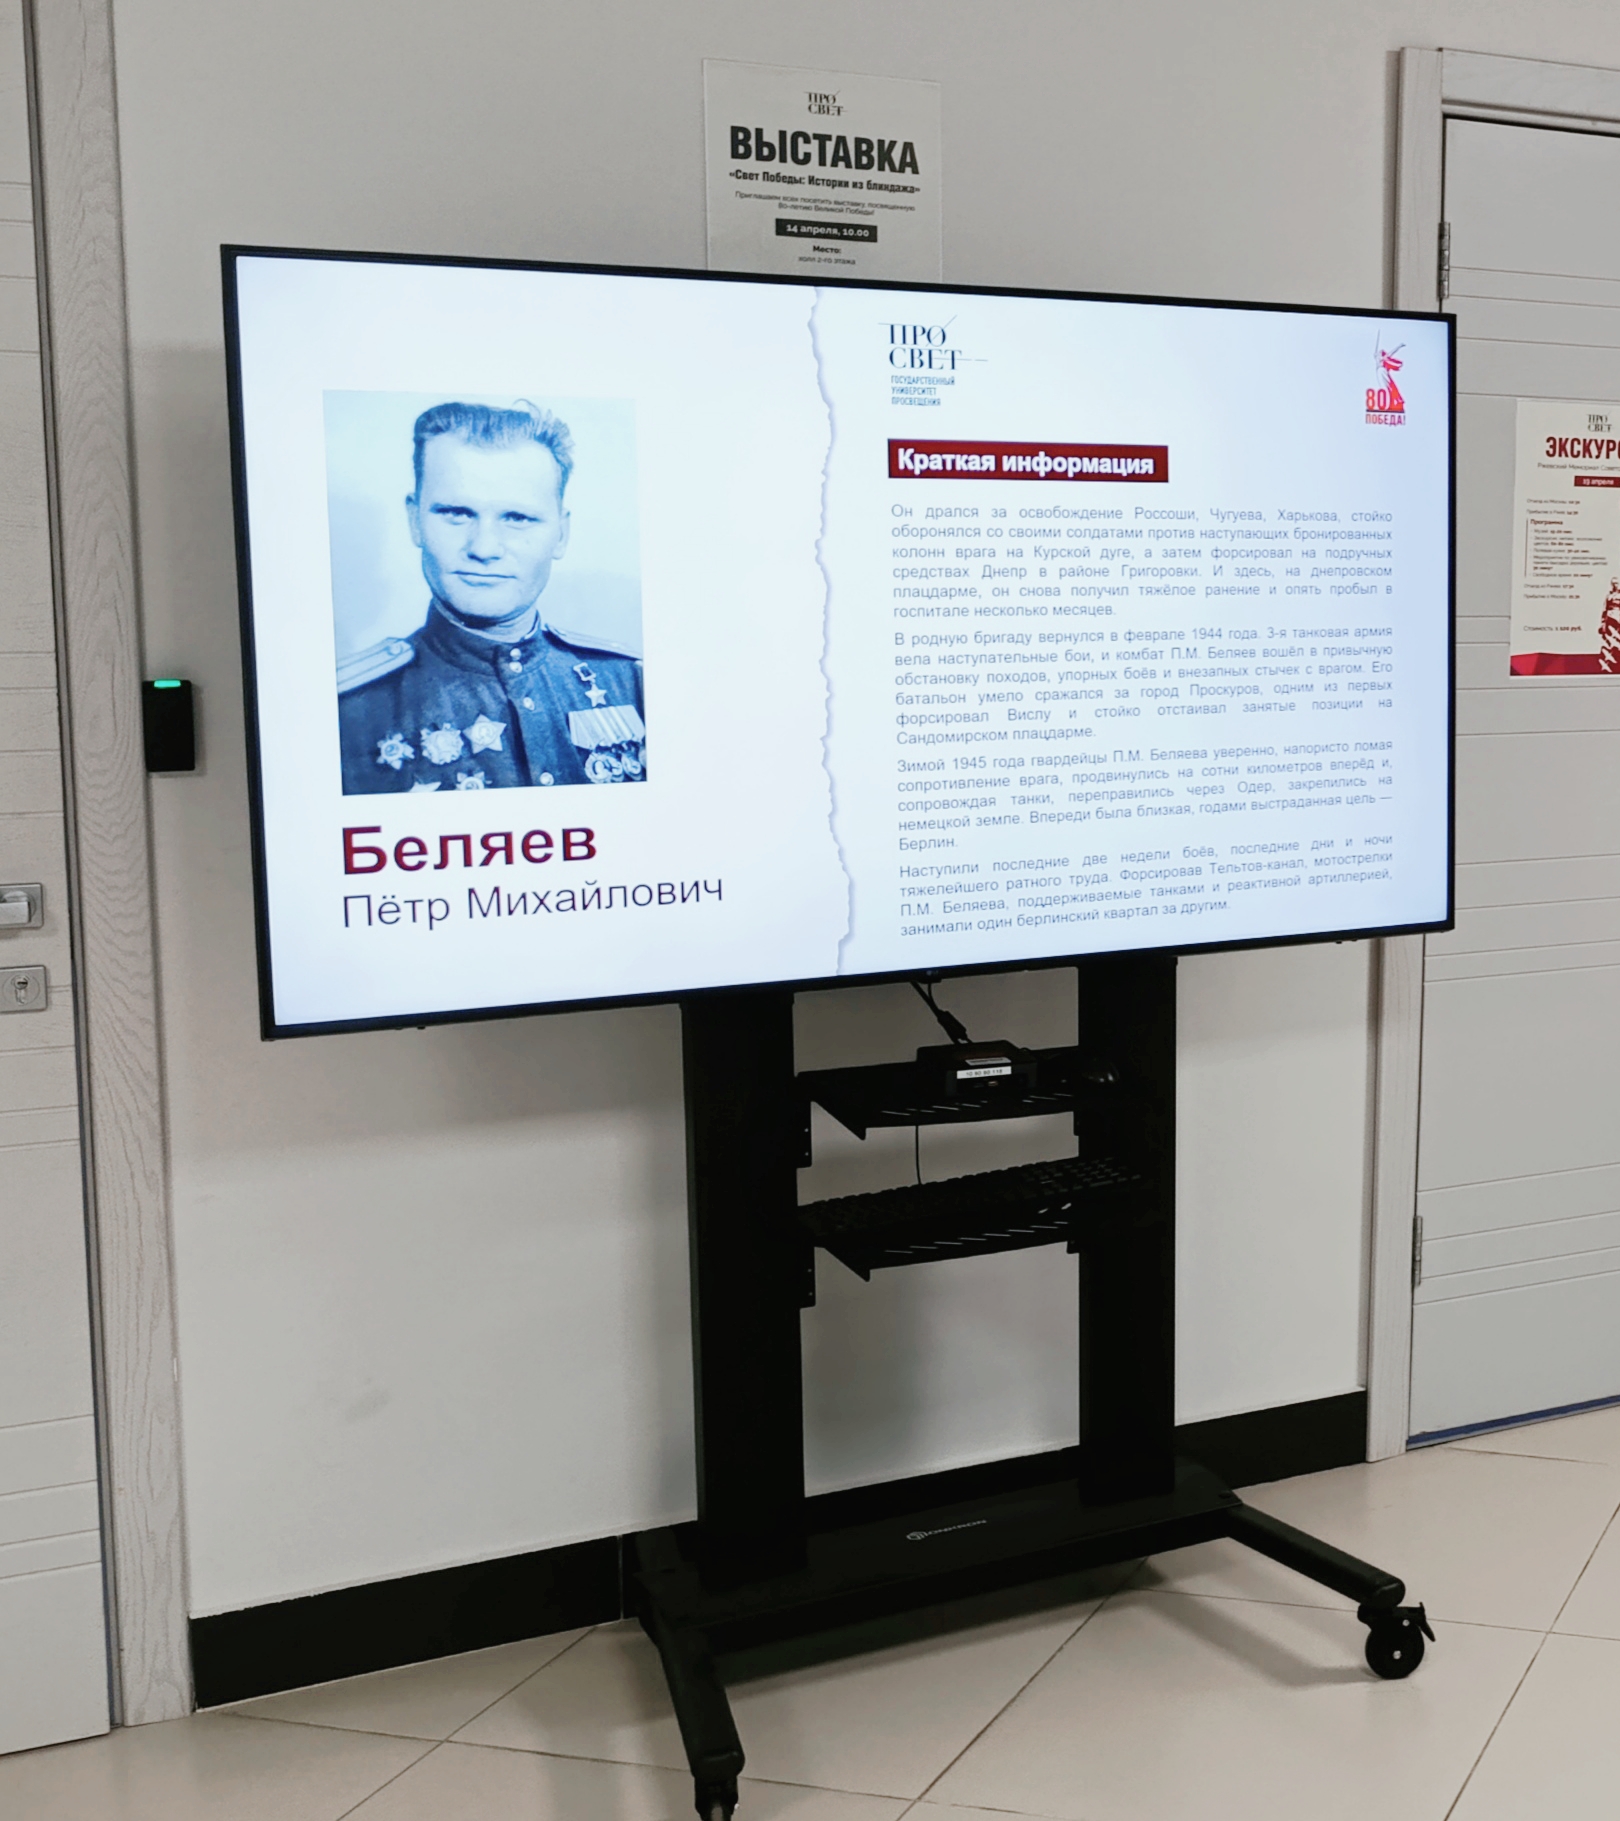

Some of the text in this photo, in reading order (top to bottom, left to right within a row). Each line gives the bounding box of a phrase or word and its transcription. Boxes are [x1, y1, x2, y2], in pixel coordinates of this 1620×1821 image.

[805, 91, 838, 105] ПРО
[807, 104, 845, 116] СВЕТ
[730, 125, 920, 175] ВЫСТАВКА
[729, 169, 921, 194] «Свет Победы: Истории из блиндажа»
[787, 224, 797, 233] 14
[800, 225, 841, 237] апреля,
[888, 323, 947, 347] ПРО
[889, 347, 963, 370] СВЕТ
[891, 386, 937, 396] УНИВЕРСИТЕТ
[1366, 388, 1387, 411] 80
[1365, 413, 1406, 427] ПОБЕДА!
[898, 448, 1155, 477] Краткая информация
[891, 503, 1393, 524] Он дрался за освобождение Россоши, Чугуева, Харькова, стойко
[891, 523, 1392, 542] оборонялся со своими солдатами против наступающих бронированных
[892, 545, 1392, 561] колонн врага на Курской дуге, а затем форсировал на подручных
[892, 564, 1392, 581] средствах Днепр в районе Григоровки. И здесь, на днепровском
[893, 582, 1393, 600] плацдарме, он снова получил тяжёлое ранение и опять пробыл в
[894, 605, 1116, 618] госпитале несколько месяцев.
[894, 626, 1393, 648] В родную бригаду вернулся в феврале 1944 года. 3-я танковая армия
[896, 727, 1096, 746] Сандомирском плацдарме.
[897, 758, 945, 773] Зимой
[952, 755, 987, 770] 1945
[993, 757, 1025, 770] года
[1031, 752, 1107, 768] гвардейцы
[1150, 748, 1208, 761] Беляева
[1213, 746, 1278, 761] уверенно,
[1283, 743, 1350, 756] напористо
[1354, 741, 1393, 752] ломая
[341, 825, 597, 875] Беляев
[899, 837, 958, 853] Берлин.
[899, 853, 1393, 897] тяжелейшего ратного труда. Форсировав Тельтов-канал, мотострелки
[942, 899, 1009, 914] Беляева,
[1018, 889, 1142, 909] поддерживаемые
[1149, 884, 1205, 897] танками
[1212, 883, 1220, 892] и
[1227, 875, 1301, 894] реактивной
[1308, 868, 1392, 887] артиллерией,
[343, 879, 723, 931] Пётр Михайлович
[900, 901, 1230, 936] занимали один берлинский квартал за другим.
